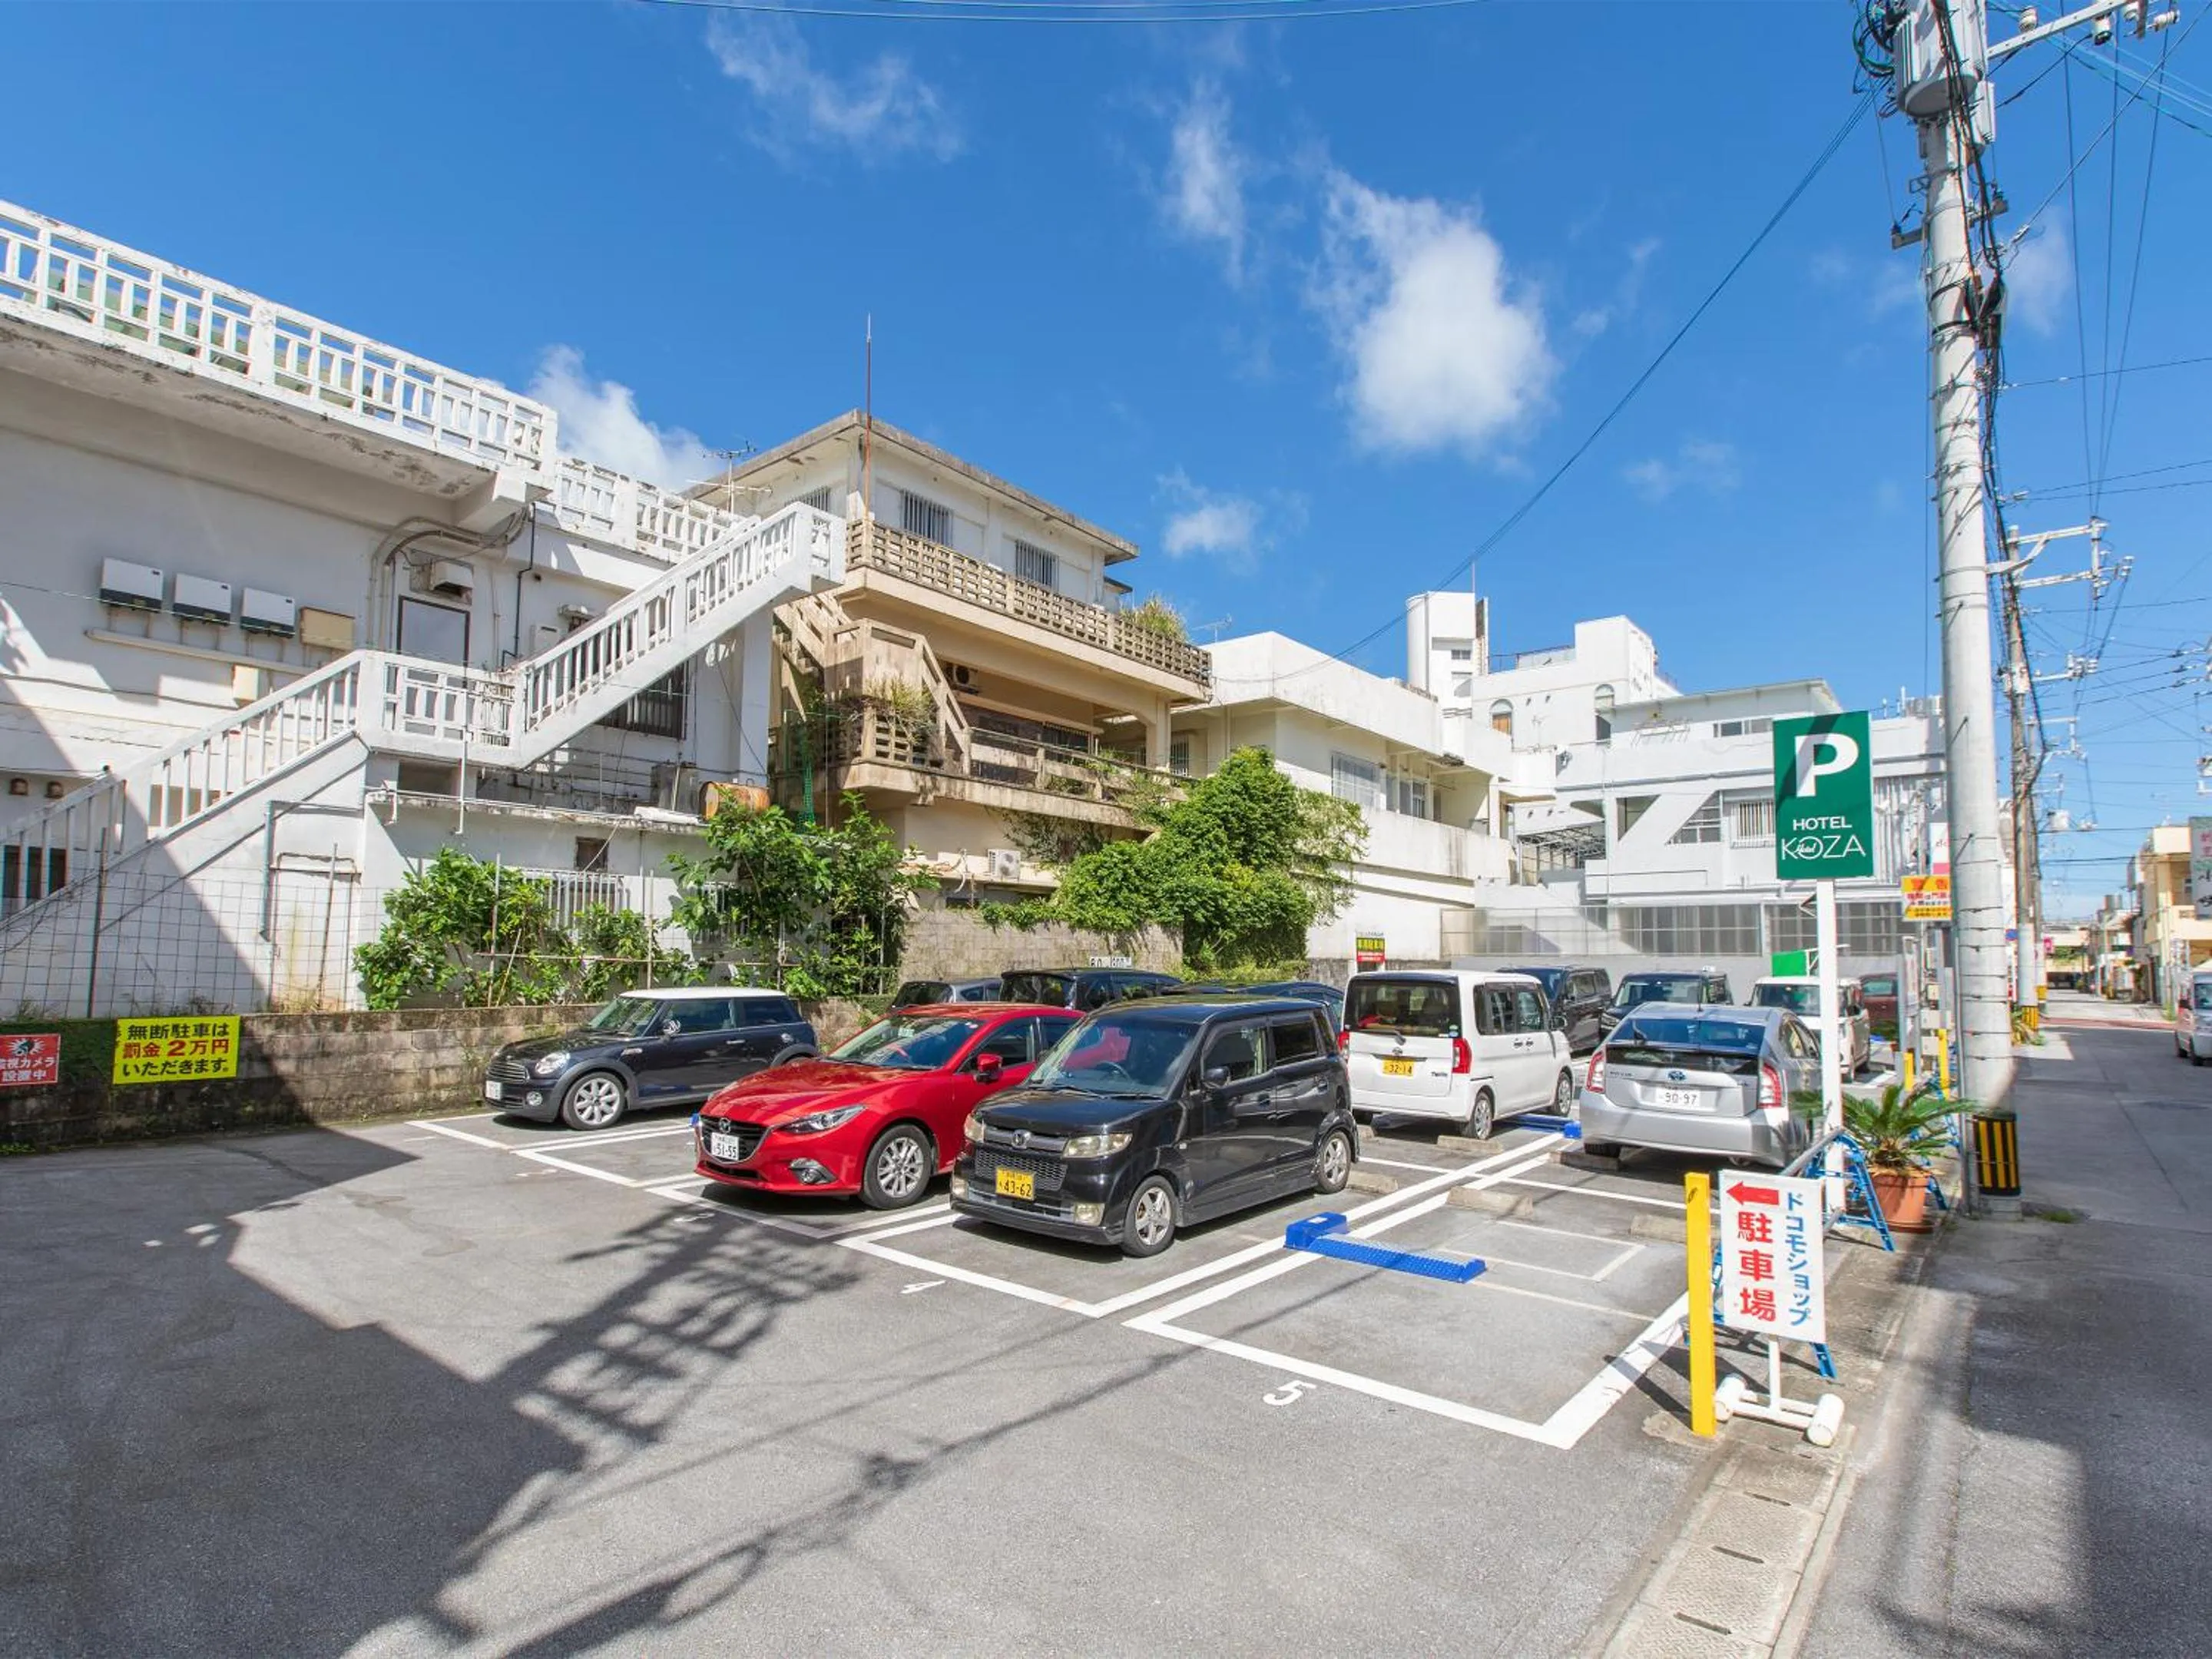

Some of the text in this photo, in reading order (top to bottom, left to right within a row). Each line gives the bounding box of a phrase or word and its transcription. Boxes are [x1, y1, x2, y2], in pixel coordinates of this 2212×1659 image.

[1794, 732, 1859, 797] P
[1792, 816, 1853, 831] HOTEL
[1781, 834, 1867, 860] KOZA
[127, 1022, 230, 1040] 無断駐車は
[1004, 1179, 1031, 1197] 43-62
[1737, 1210, 1777, 1323] 駐車場
[1785, 1191, 1811, 1326] ドコモショップ
[1262, 1379, 1317, 1406] 5
